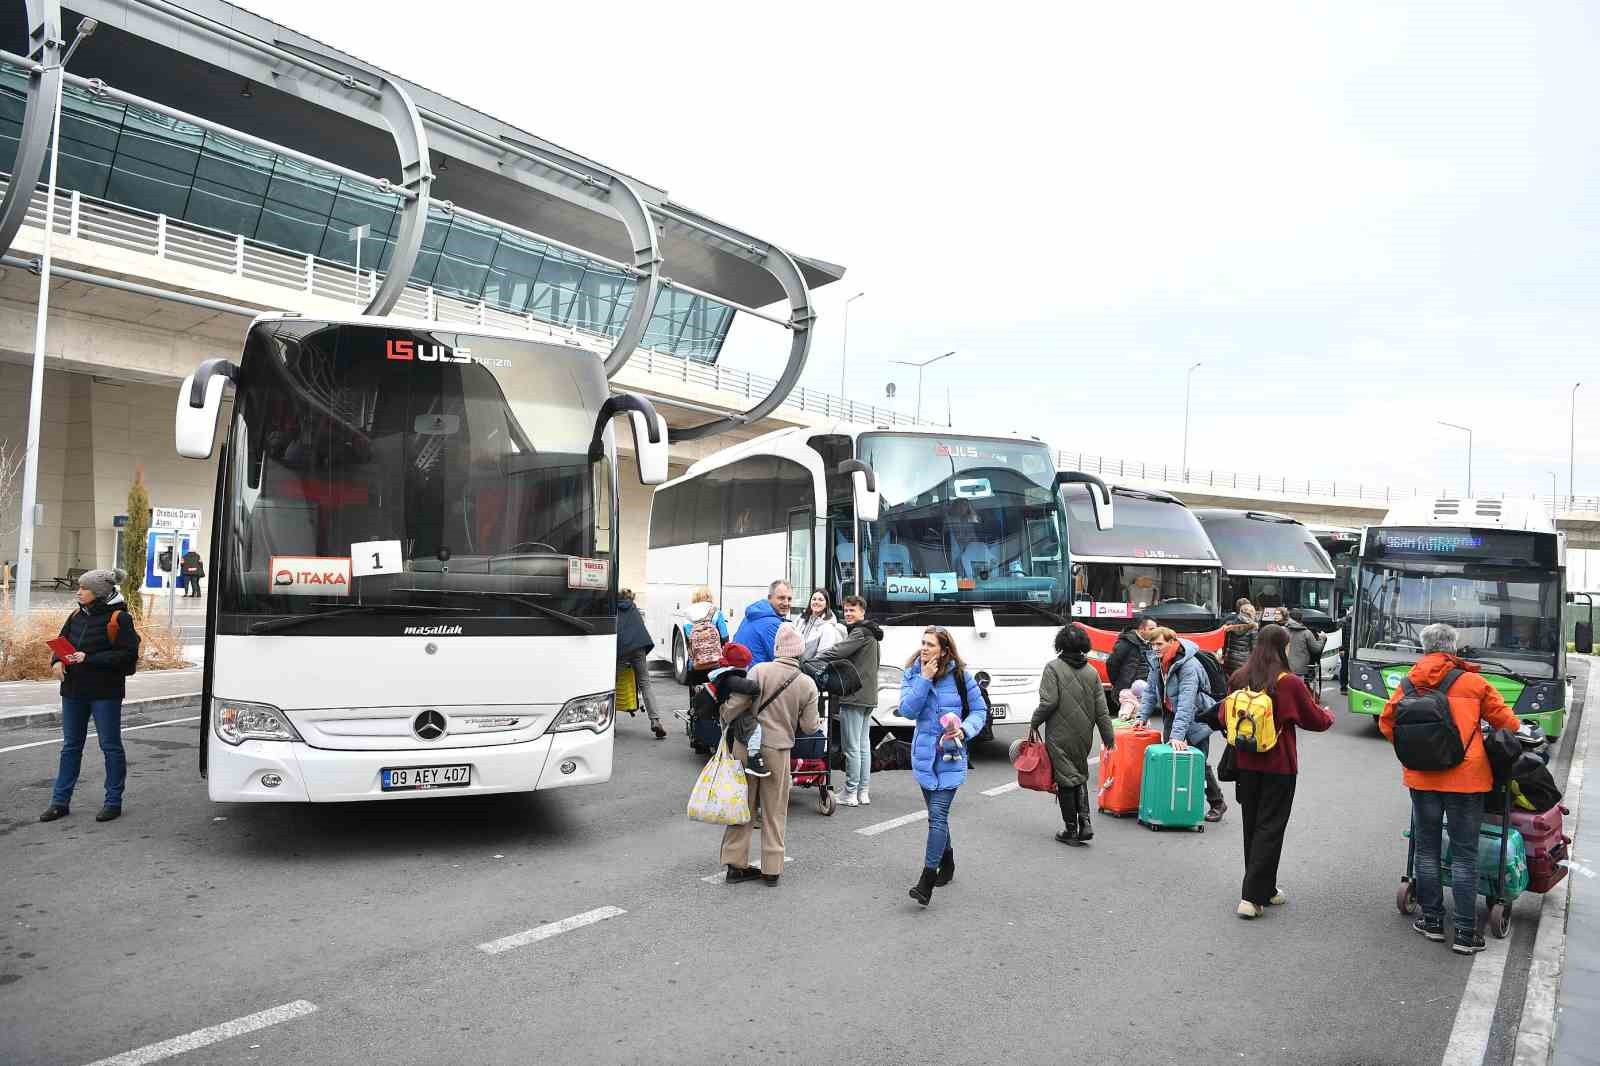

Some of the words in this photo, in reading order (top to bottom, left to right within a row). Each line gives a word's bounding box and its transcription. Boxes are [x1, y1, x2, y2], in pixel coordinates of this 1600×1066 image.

[417, 344, 472, 364] ULS
[371, 551, 384, 570] 1
[296, 571, 347, 585] ITAKA
[940, 579, 948, 591] 2
[900, 584, 929, 594] ITAKA
[1076, 606, 1084, 615] 3
[392, 770, 408, 785] 09
[414, 769, 439, 784] AEY
[444, 767, 467, 782] 407
